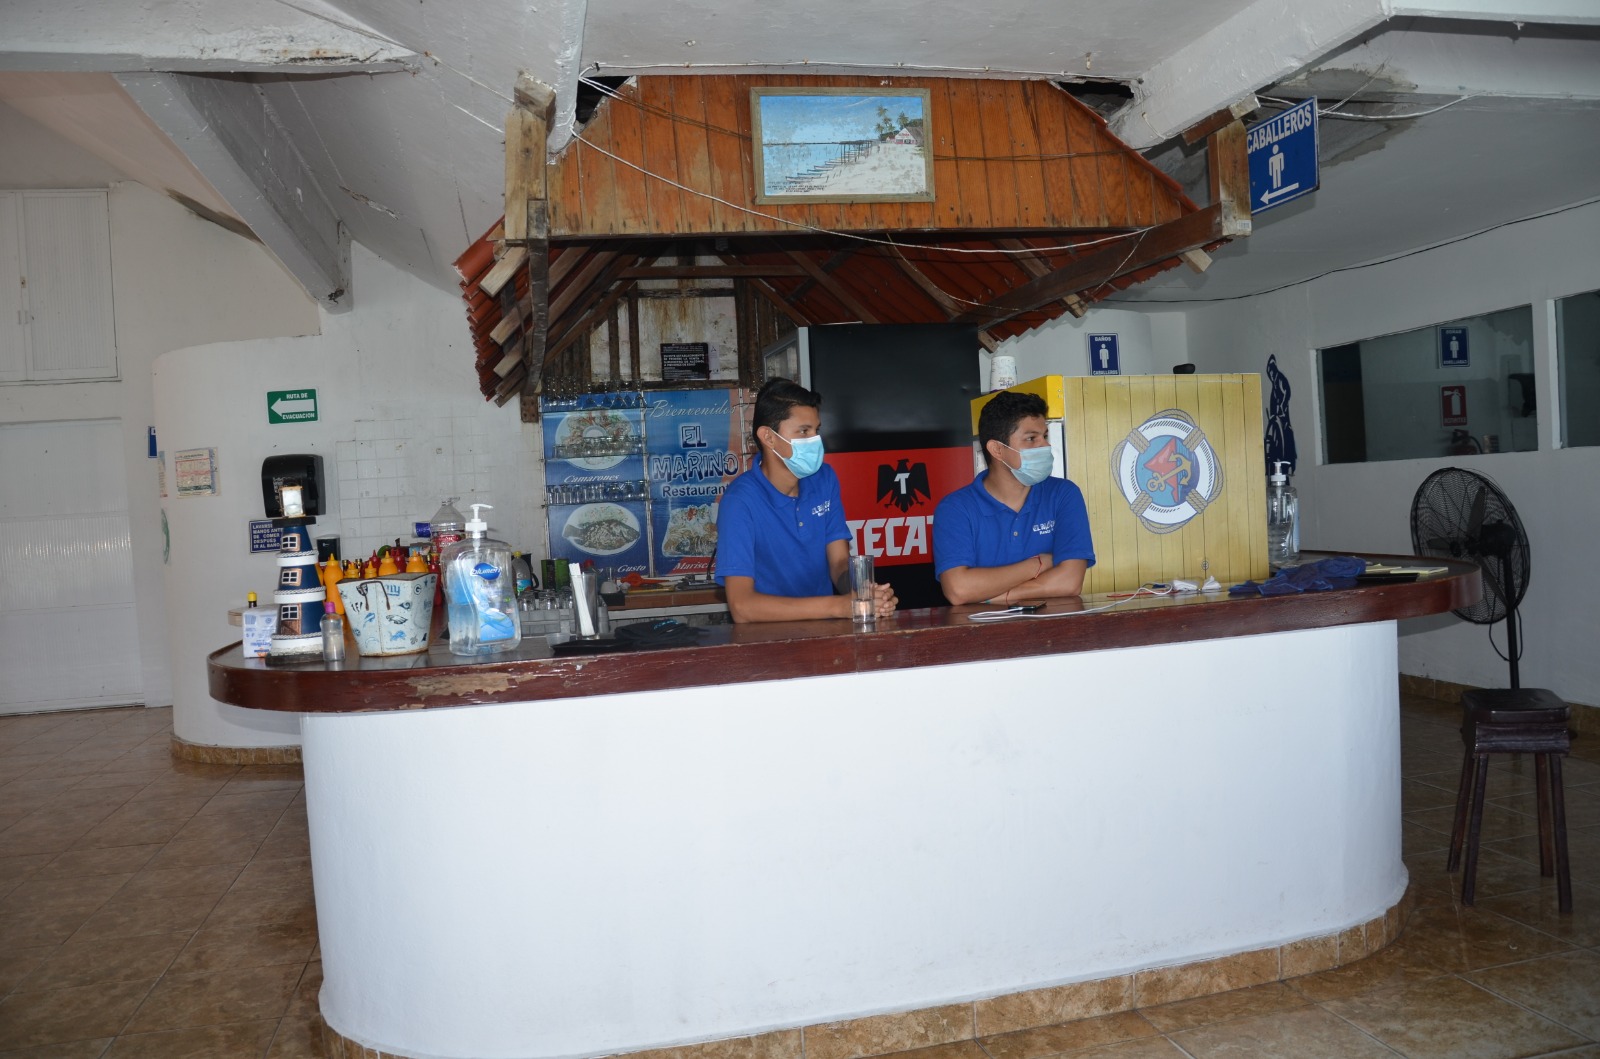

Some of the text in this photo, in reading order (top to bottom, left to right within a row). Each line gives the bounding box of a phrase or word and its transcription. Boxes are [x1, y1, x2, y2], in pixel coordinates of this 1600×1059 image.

[1247, 105, 1312, 154] CABALLEROS
[680, 424, 708, 449] EL
[563, 474, 620, 483] Camarones
[652, 451, 739, 482] MARINO
[894, 473, 910, 494] T
[846, 515, 934, 557] TECA
[617, 564, 647, 573] Gusto
